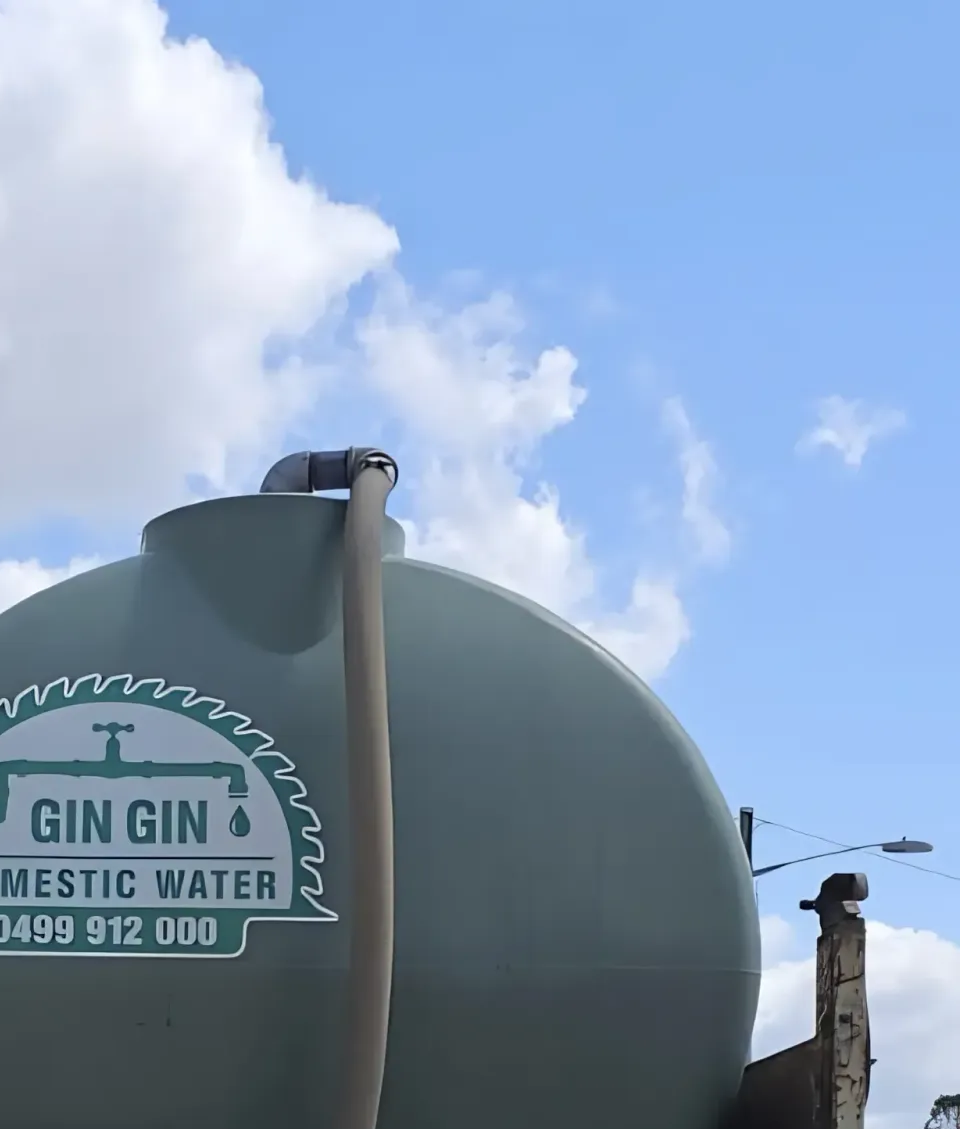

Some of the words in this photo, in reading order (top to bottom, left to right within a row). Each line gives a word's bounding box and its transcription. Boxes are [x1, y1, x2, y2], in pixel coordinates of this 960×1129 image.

[31, 798, 111, 843] GIN
[126, 799, 208, 844] GIN
[156, 869, 276, 900] WATER
[86, 915, 143, 946] 912
[155, 916, 218, 946] 000
